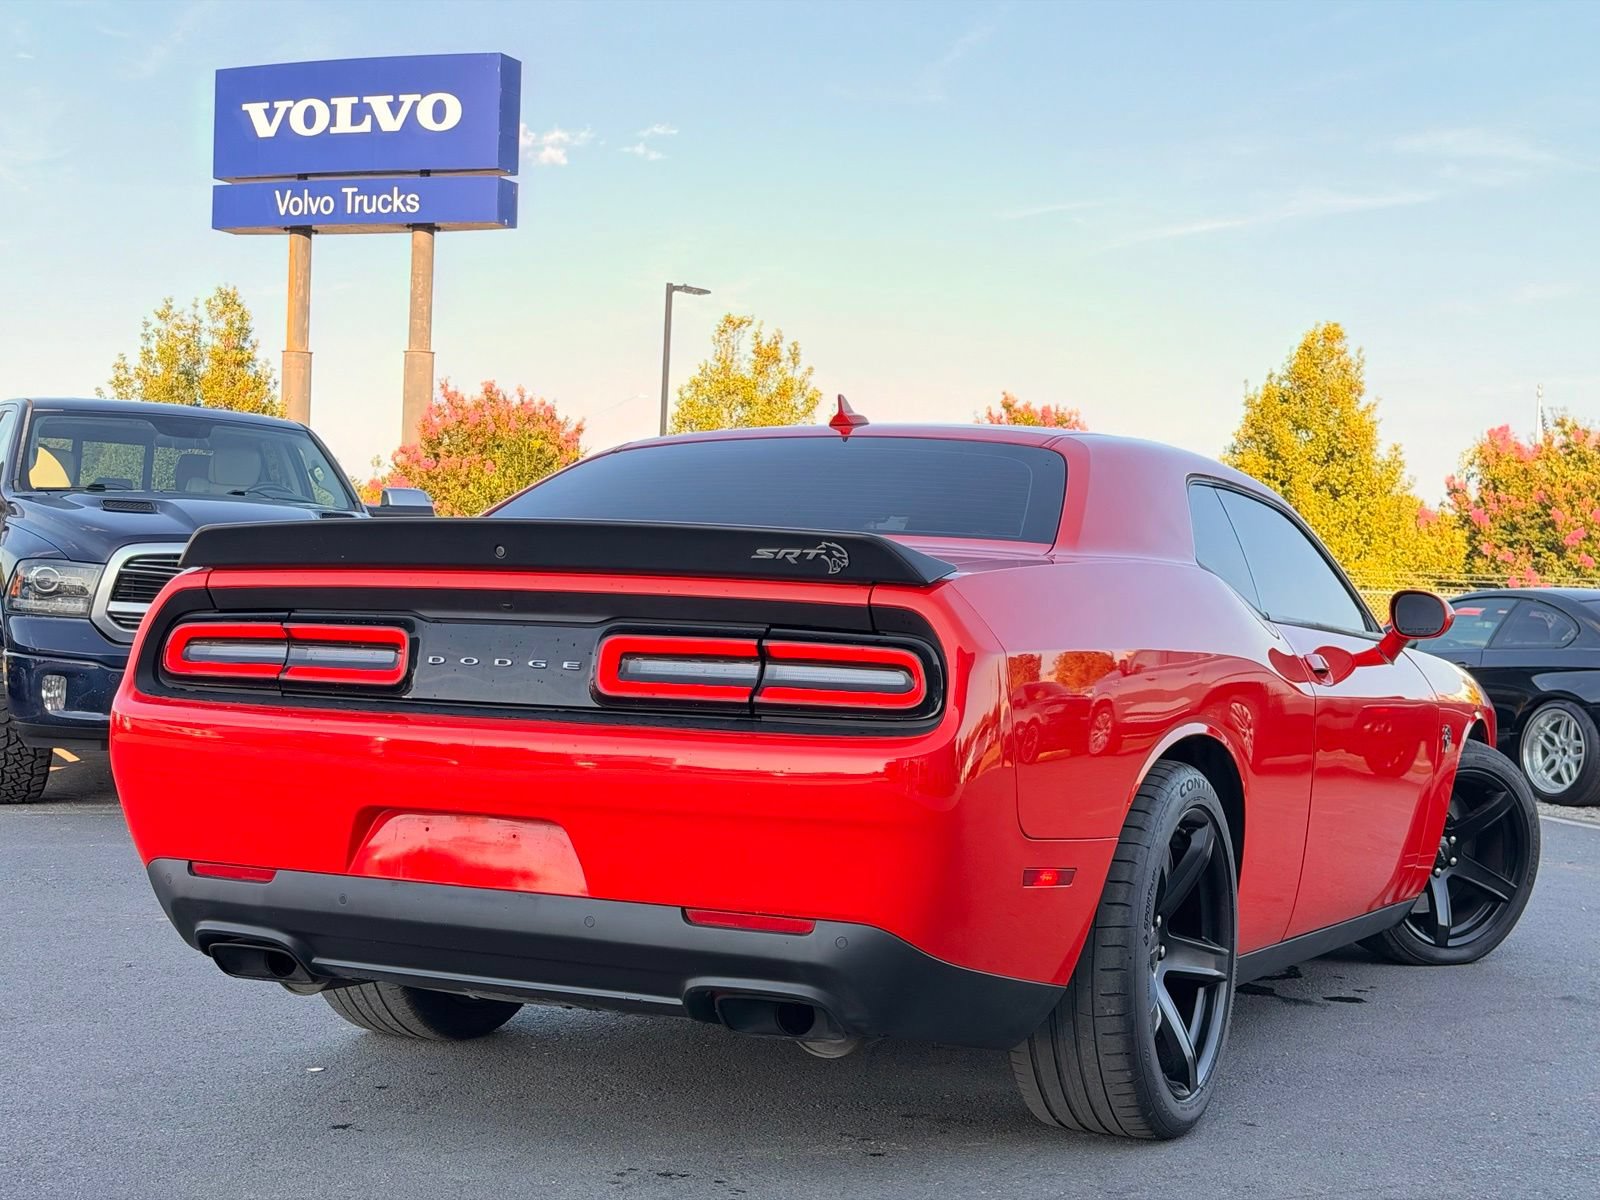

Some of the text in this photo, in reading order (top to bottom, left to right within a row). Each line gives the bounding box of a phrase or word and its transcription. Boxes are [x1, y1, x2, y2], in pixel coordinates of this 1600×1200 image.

[241, 92, 462, 138] VOLVO
[274, 186, 420, 216] Volvo Trucks
[751, 548, 826, 564] SRT
[427, 655, 582, 670] DODGE
